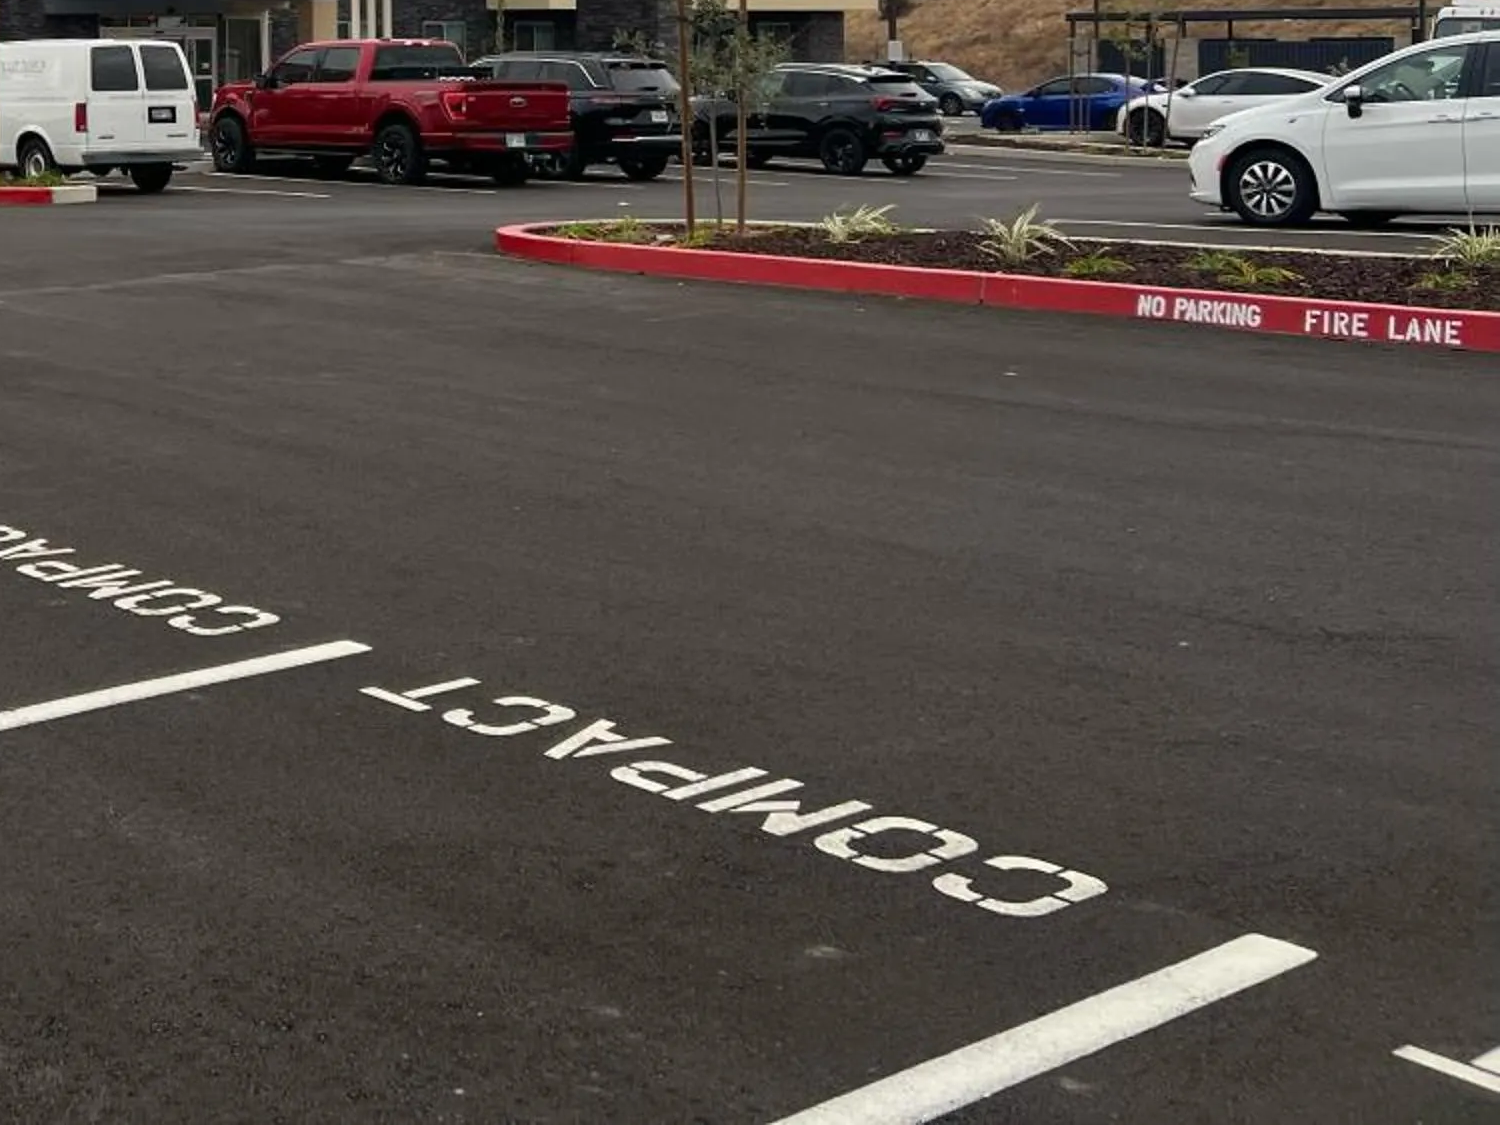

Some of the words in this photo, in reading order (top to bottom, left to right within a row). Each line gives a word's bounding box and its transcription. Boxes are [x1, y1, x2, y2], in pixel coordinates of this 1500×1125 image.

[1137, 294, 1166, 317] NO
[1173, 297, 1262, 329] PARKING
[1304, 309, 1369, 338] FIRE
[1388, 315, 1463, 345] LANE
[360, 676, 1109, 918] COMPACT
